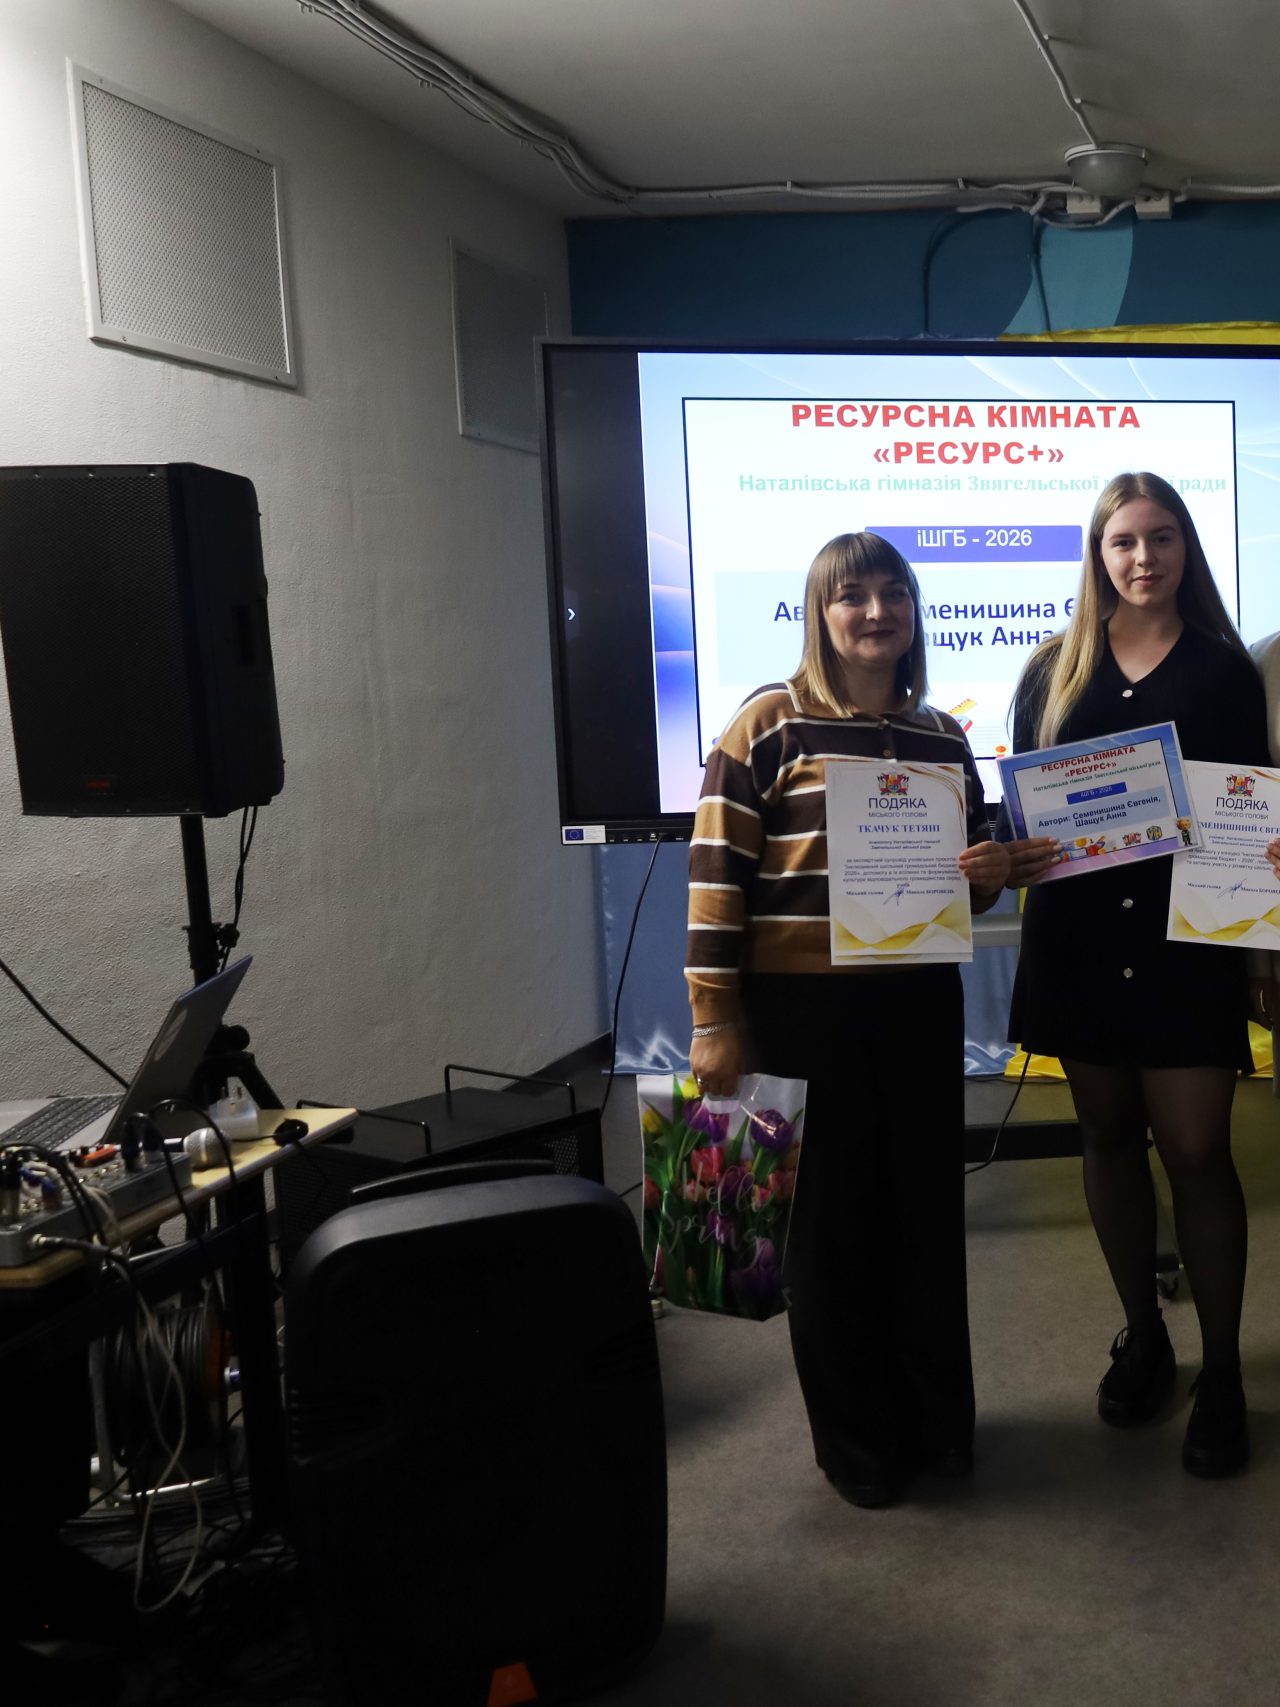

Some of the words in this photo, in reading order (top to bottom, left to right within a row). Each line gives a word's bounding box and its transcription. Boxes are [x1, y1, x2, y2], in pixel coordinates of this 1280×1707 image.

[791, 404, 976, 428] РЕСУРСНА
[987, 405, 1141, 428] КІМНАТА
[873, 441, 1064, 465] «РЕСУРС+»
[739, 474, 871, 492] Наталівська
[877, 474, 961, 492] гімназія
[968, 475, 1100, 492] Звягельської
[1180, 477, 1226, 494] ради
[917, 529, 967, 547] іШГБ
[985, 529, 1032, 547] 2026
[920, 603, 1055, 620] менишина
[924, 631, 983, 651] щук
[1041, 756, 1091, 773] РЕСУРСНА
[1092, 745, 1136, 762] КІМНАТА
[868, 797, 927, 810] ПОДЯКА
[1038, 815, 1071, 828] Автори:
[1072, 803, 1126, 820] Семенишина
[1127, 796, 1161, 808] Євгенія,
[1216, 796, 1269, 811] ПОДЯКА
[857, 824, 899, 833] ТКАЧУК
[900, 824, 940, 833] ТЕТЯНІ
[1075, 815, 1105, 828] Шащук
[1106, 811, 1127, 821] Анна
